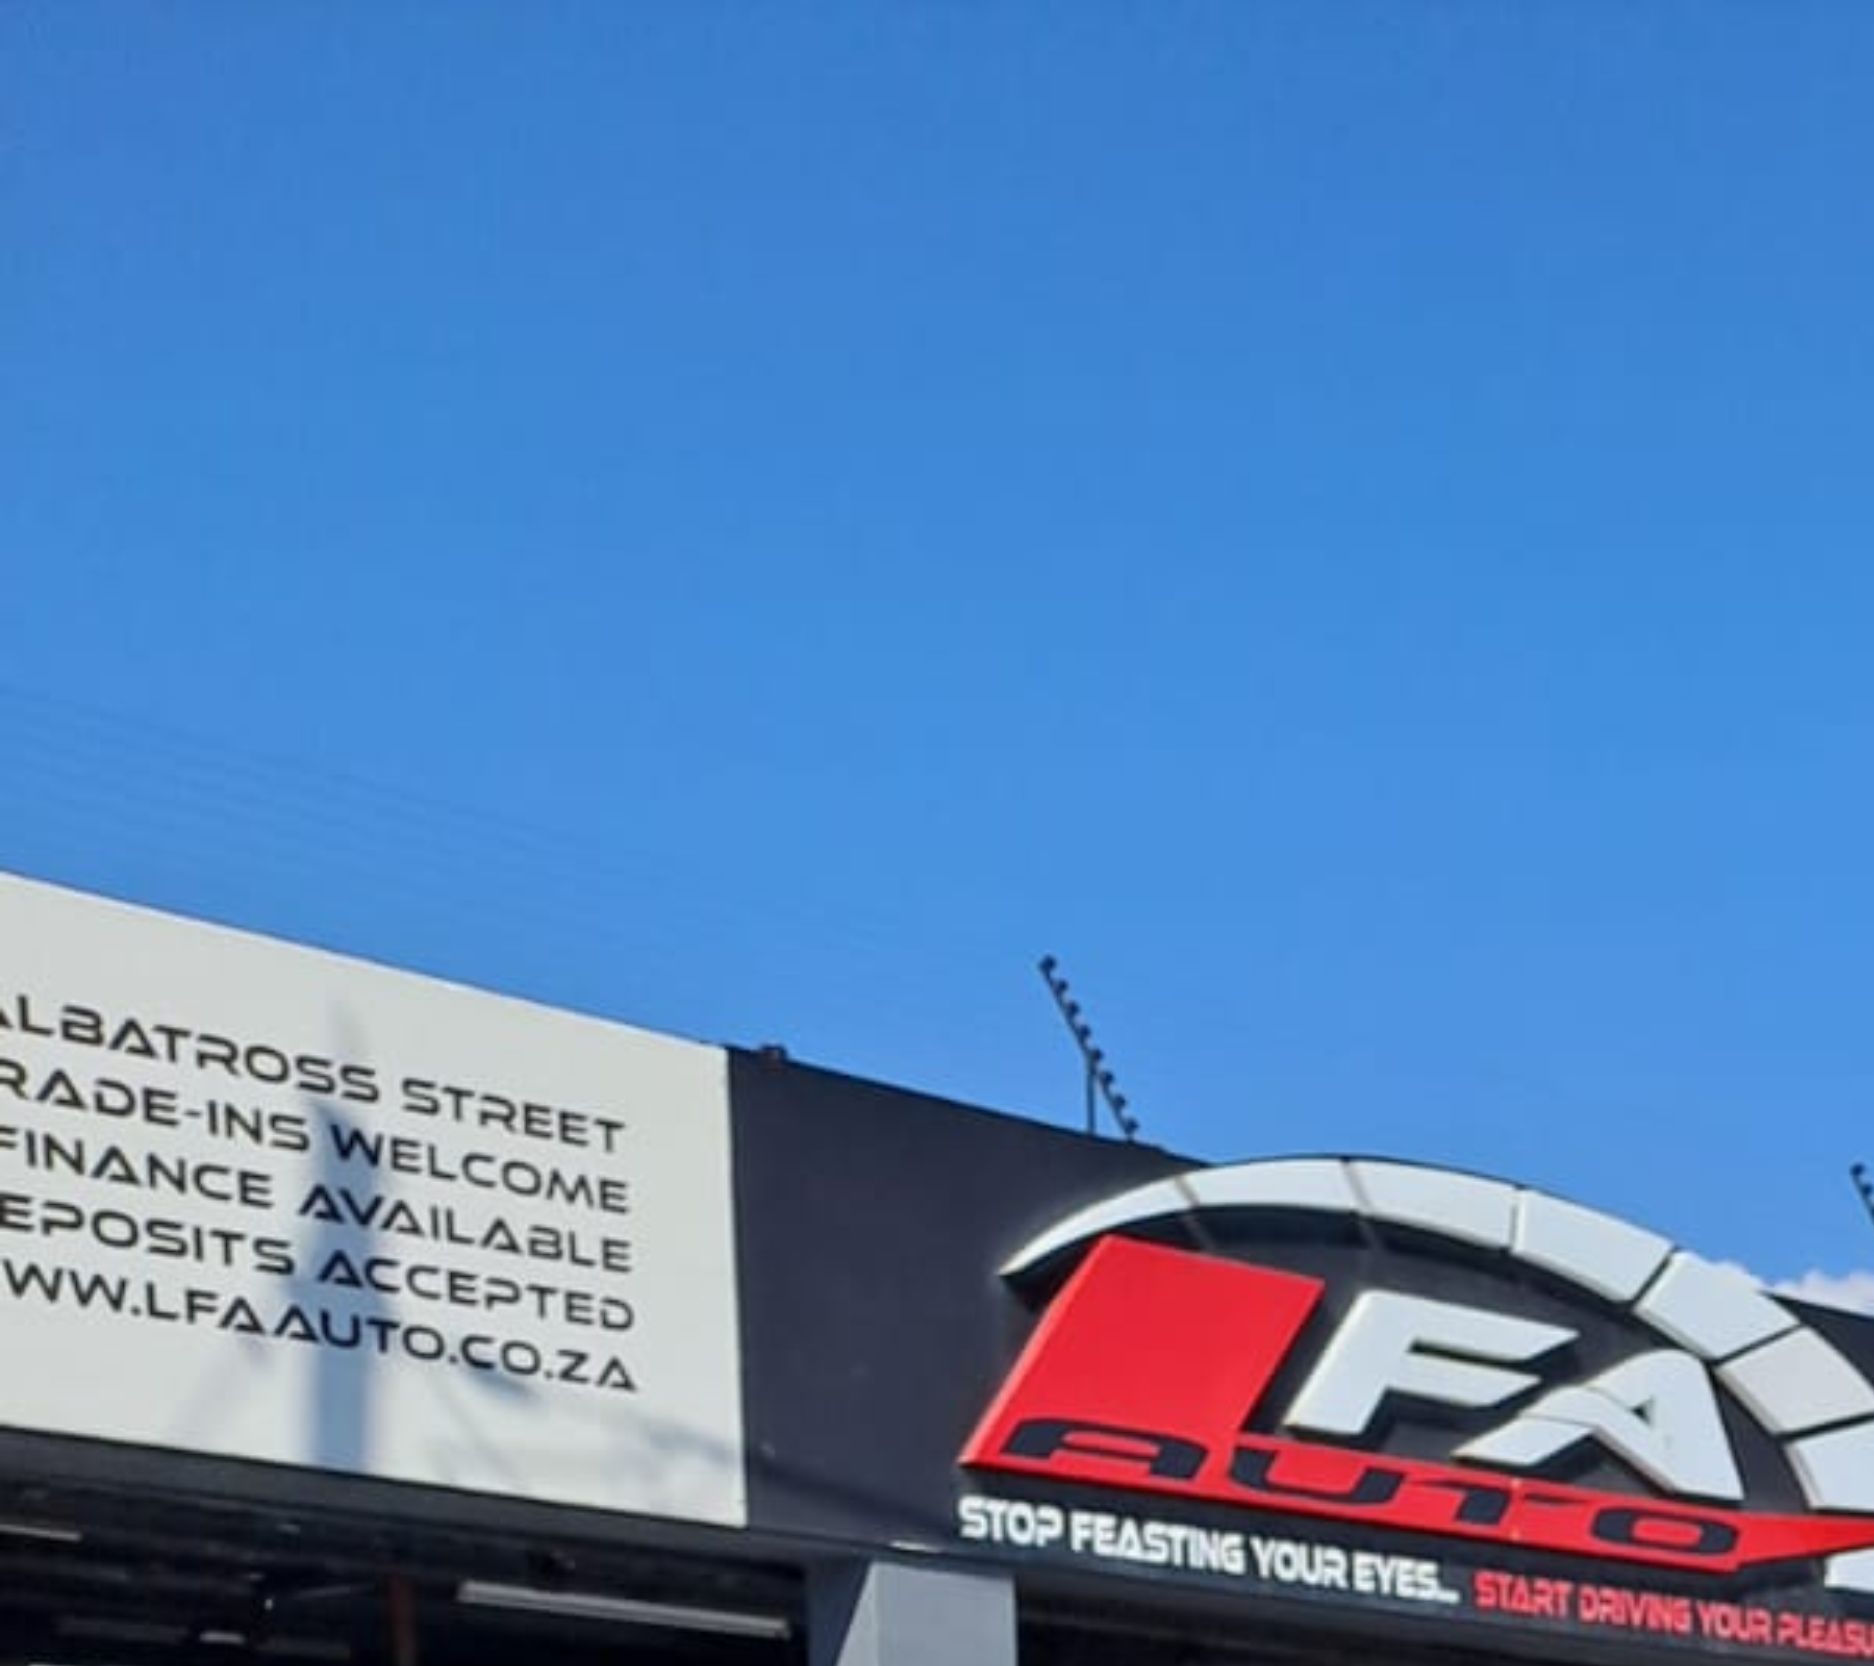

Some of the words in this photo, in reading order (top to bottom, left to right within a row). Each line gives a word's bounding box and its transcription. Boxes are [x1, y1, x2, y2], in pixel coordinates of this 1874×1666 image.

[0, 994, 381, 1104] LBATROSS
[402, 1077, 626, 1153] STREET
[331, 1122, 630, 1215] WELCOME
[298, 1183, 632, 1273] AVAILABLE
[318, 1249, 635, 1332] ACCEPTED
[1006, 1416, 1740, 1556] AUTO
[957, 1495, 1063, 1548] STOP
[1070, 1511, 1246, 1575] FEASTING
[1250, 1535, 1348, 1589] YOUR
[1473, 1569, 1573, 1618] START
[1577, 1585, 1693, 1636] DRIVING
[1697, 1602, 1773, 1643] YOUR
